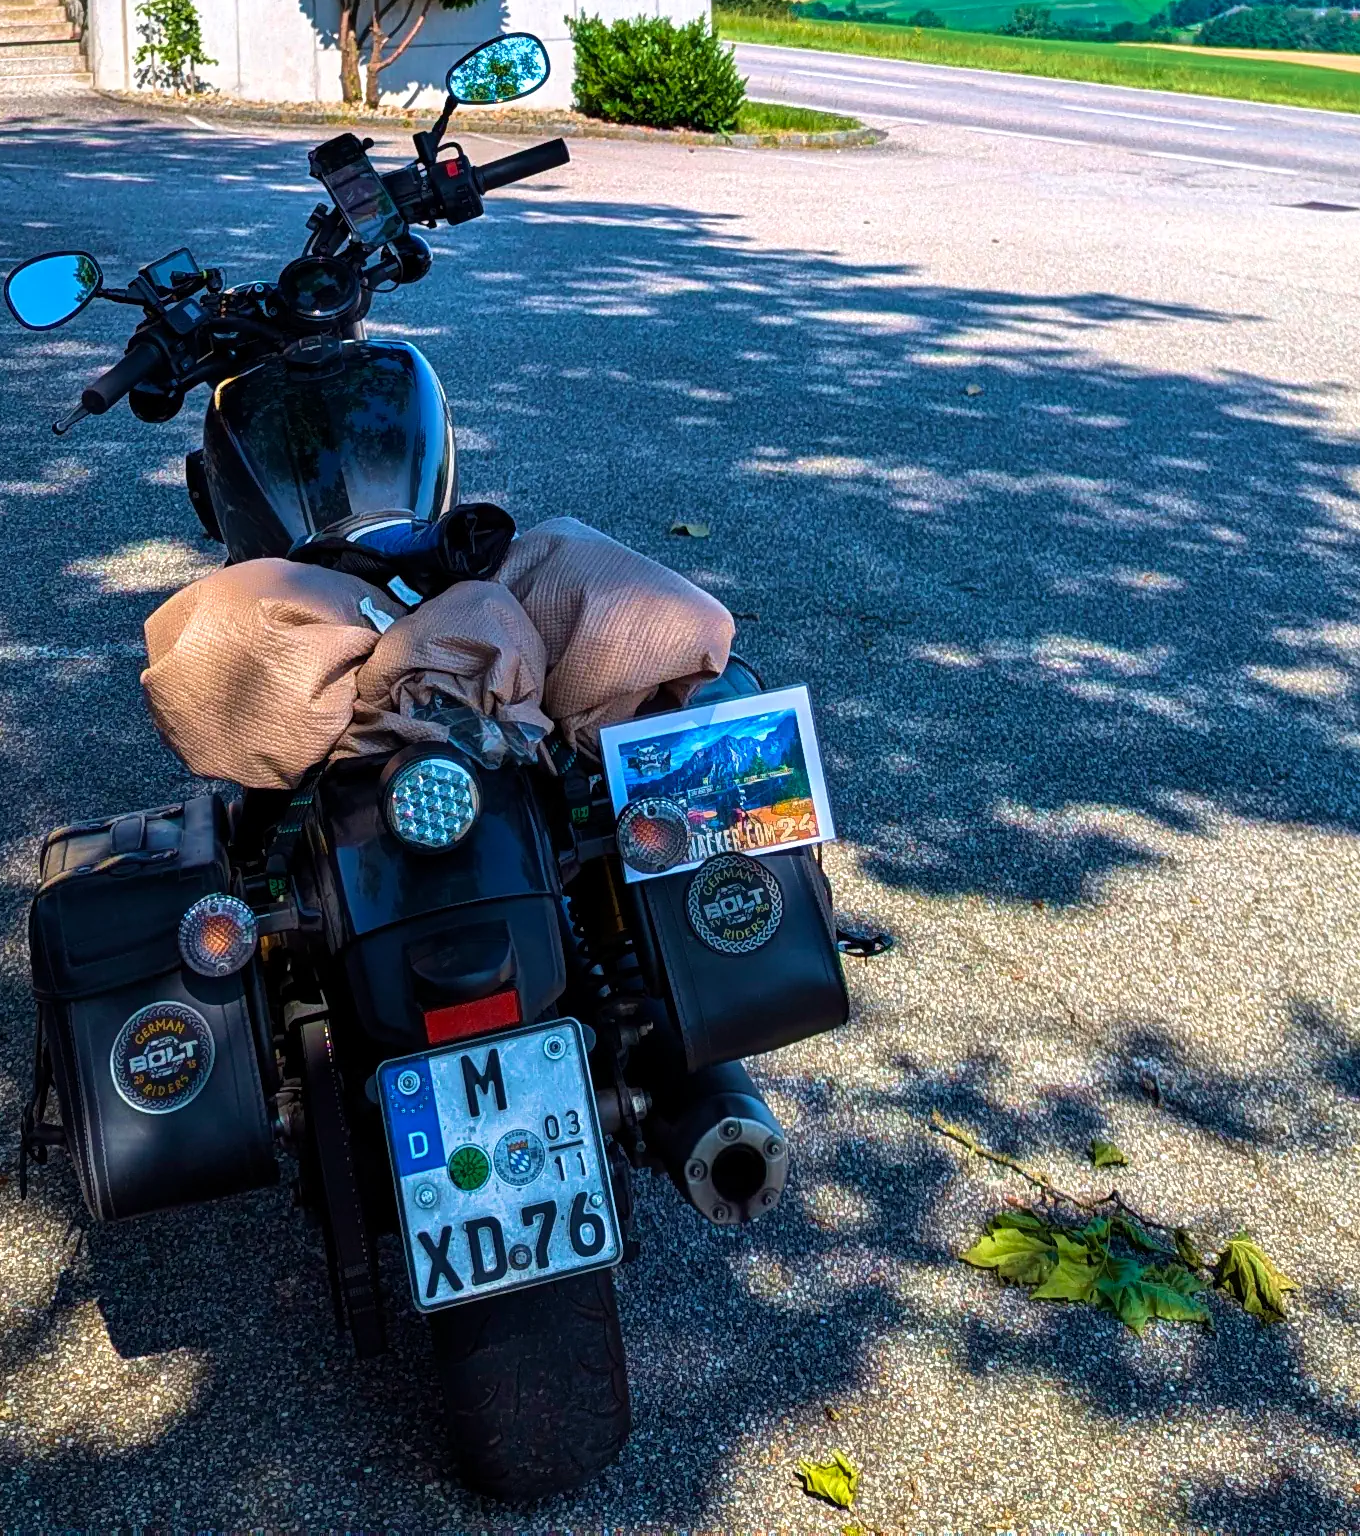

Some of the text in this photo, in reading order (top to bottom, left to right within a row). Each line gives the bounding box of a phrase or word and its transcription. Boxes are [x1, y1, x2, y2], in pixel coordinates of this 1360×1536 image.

[702, 868, 754, 896] GERMAN
[703, 887, 765, 921] BOLT
[723, 917, 766, 941] RIDERS
[135, 1018, 186, 1045] GERMAN
[129, 1039, 199, 1074] BOLT
[143, 1074, 189, 1097] RIDERS
[460, 1048, 508, 1117] M
[544, 1109, 581, 1141] 03
[408, 1131, 429, 1160] D
[554, 1151, 586, 1182] 11
[417, 1191, 607, 1299] XD 76
